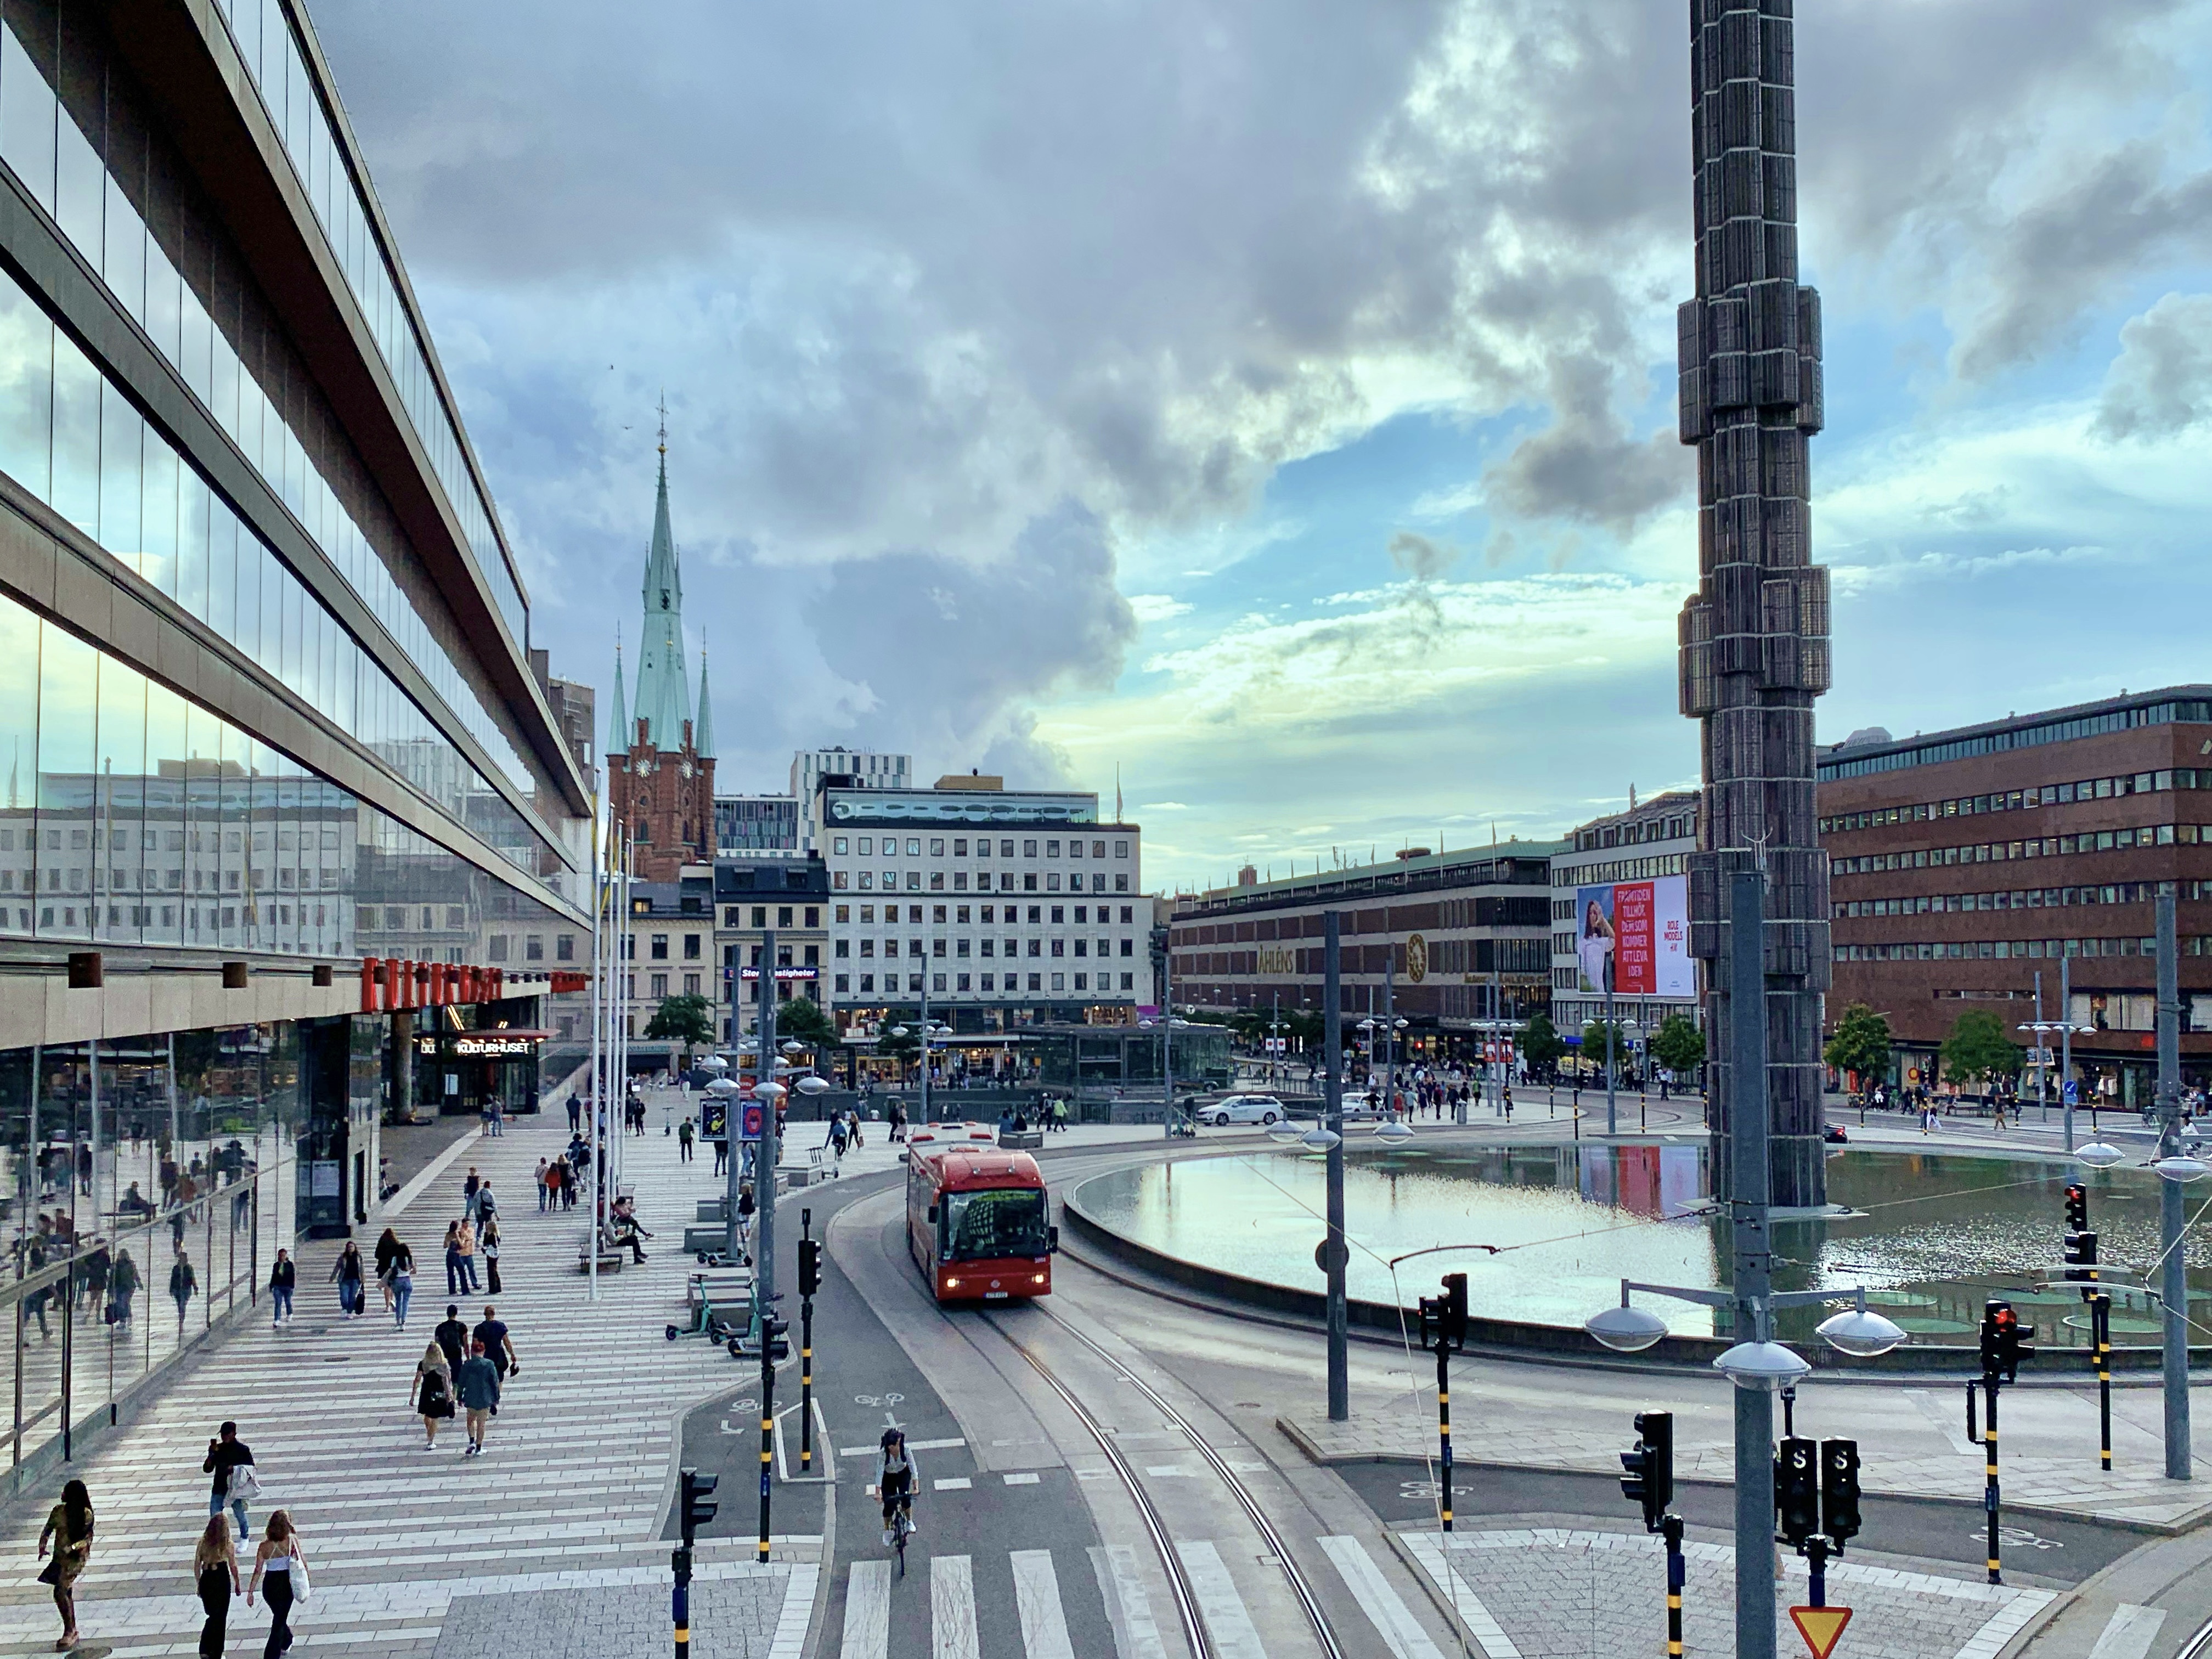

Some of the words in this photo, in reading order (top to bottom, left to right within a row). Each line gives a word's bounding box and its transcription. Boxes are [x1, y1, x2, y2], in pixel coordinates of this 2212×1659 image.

[1618, 889, 1650, 902] FRAMTIDEN
[1623, 950, 1633, 962] ATT
[457, 1043, 529, 1053] KULTURHUSET
